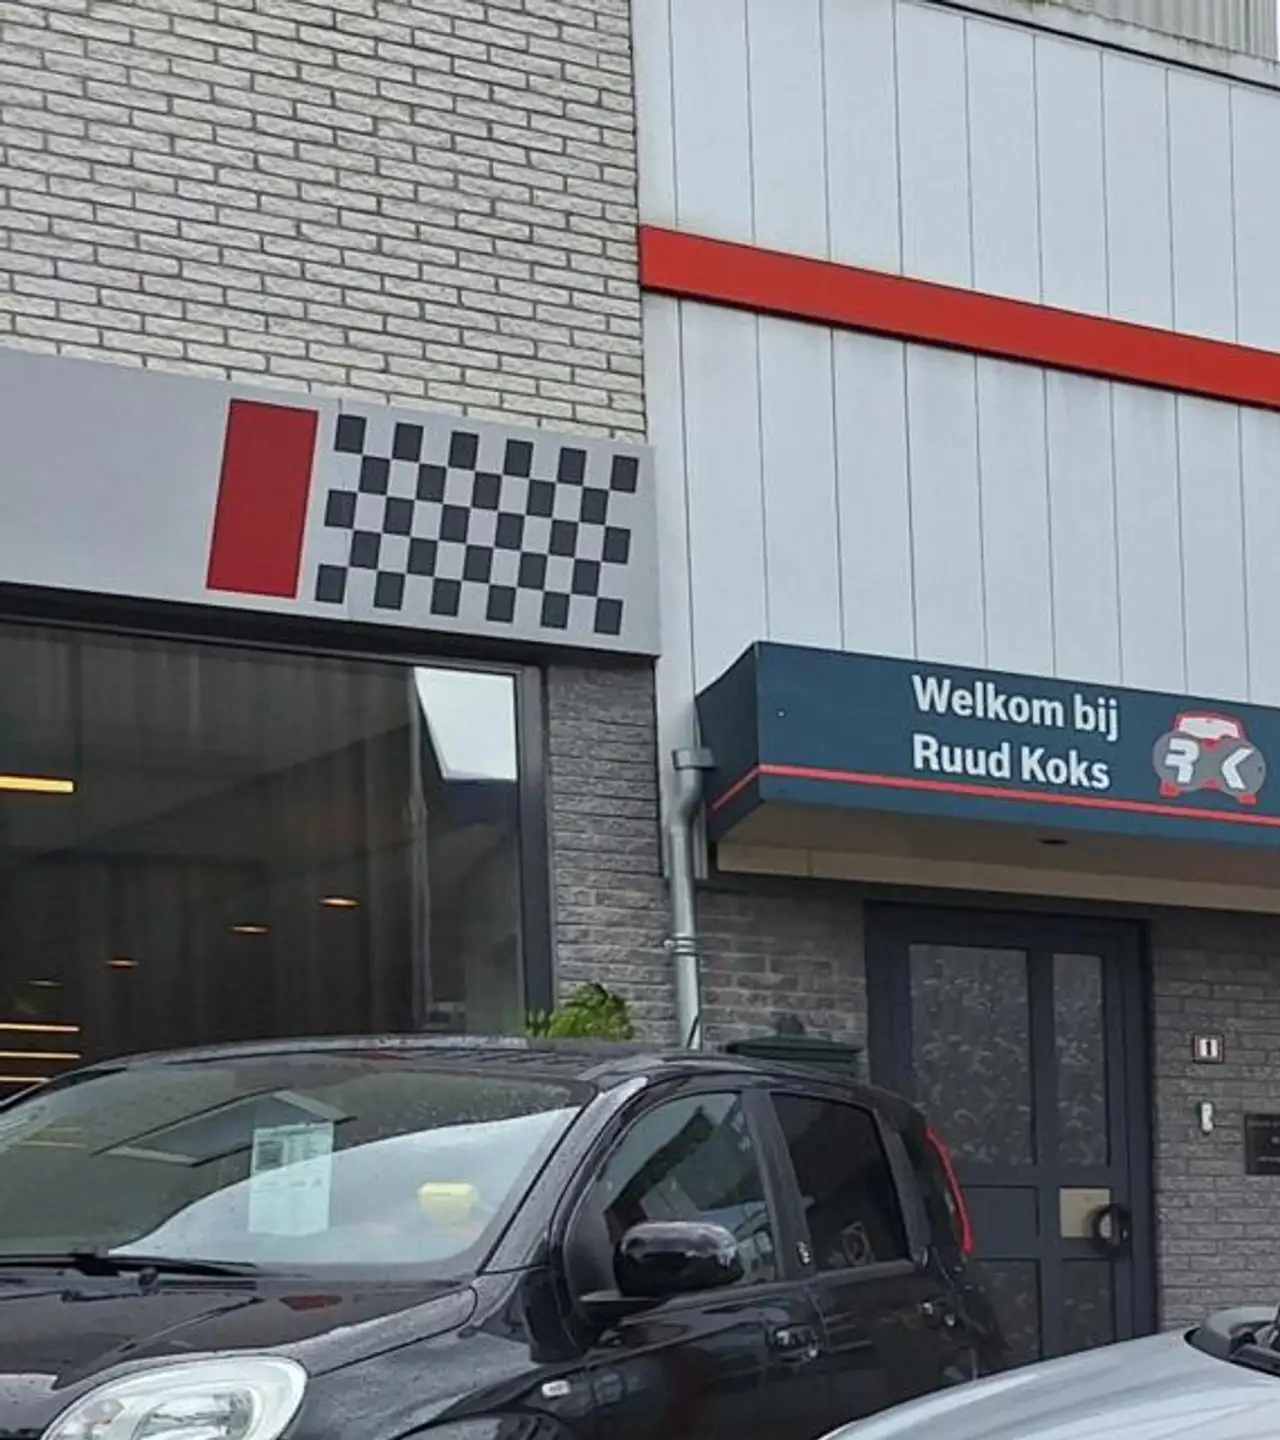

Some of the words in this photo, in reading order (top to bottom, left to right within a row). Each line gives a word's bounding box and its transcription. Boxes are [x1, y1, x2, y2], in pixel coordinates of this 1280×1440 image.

[912, 674, 1064, 727] Welkom
[1074, 694, 1119, 742] bij
[913, 733, 1011, 780] Ruud
[1021, 744, 1111, 790] Koks
